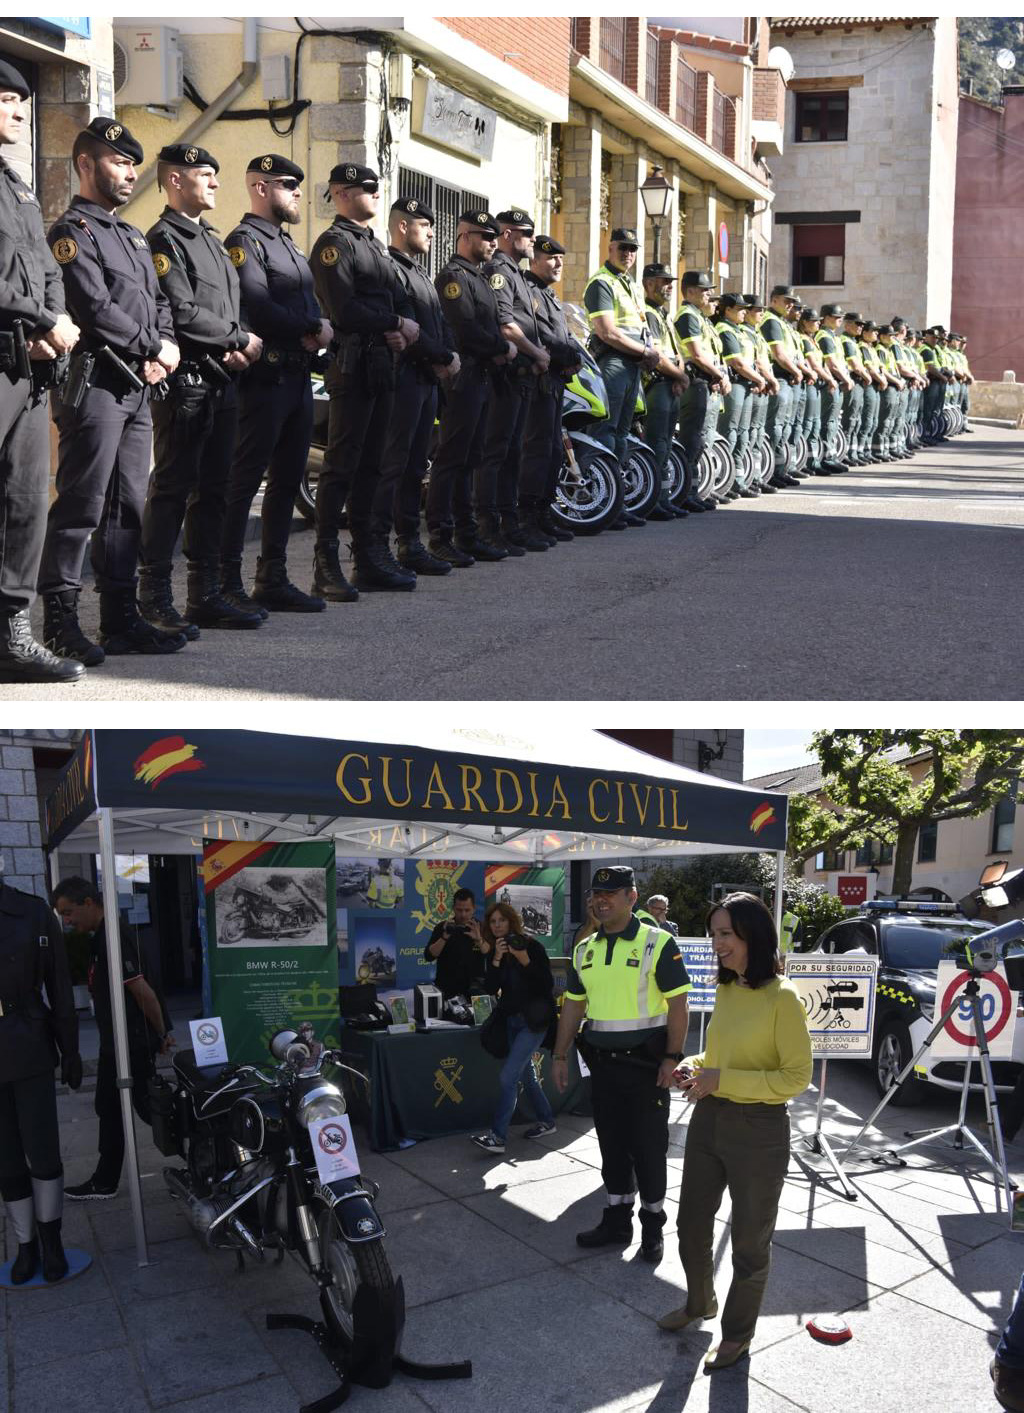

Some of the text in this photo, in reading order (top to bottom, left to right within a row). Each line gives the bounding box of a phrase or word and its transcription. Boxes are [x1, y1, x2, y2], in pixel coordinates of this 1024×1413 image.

[335, 752, 689, 831] GUARDIA CIVIL
[246, 960, 299, 970] BMW R-50/2
[790, 964, 872, 972] POR SU SEGURIDAD
[958, 993, 996, 1021] 90
